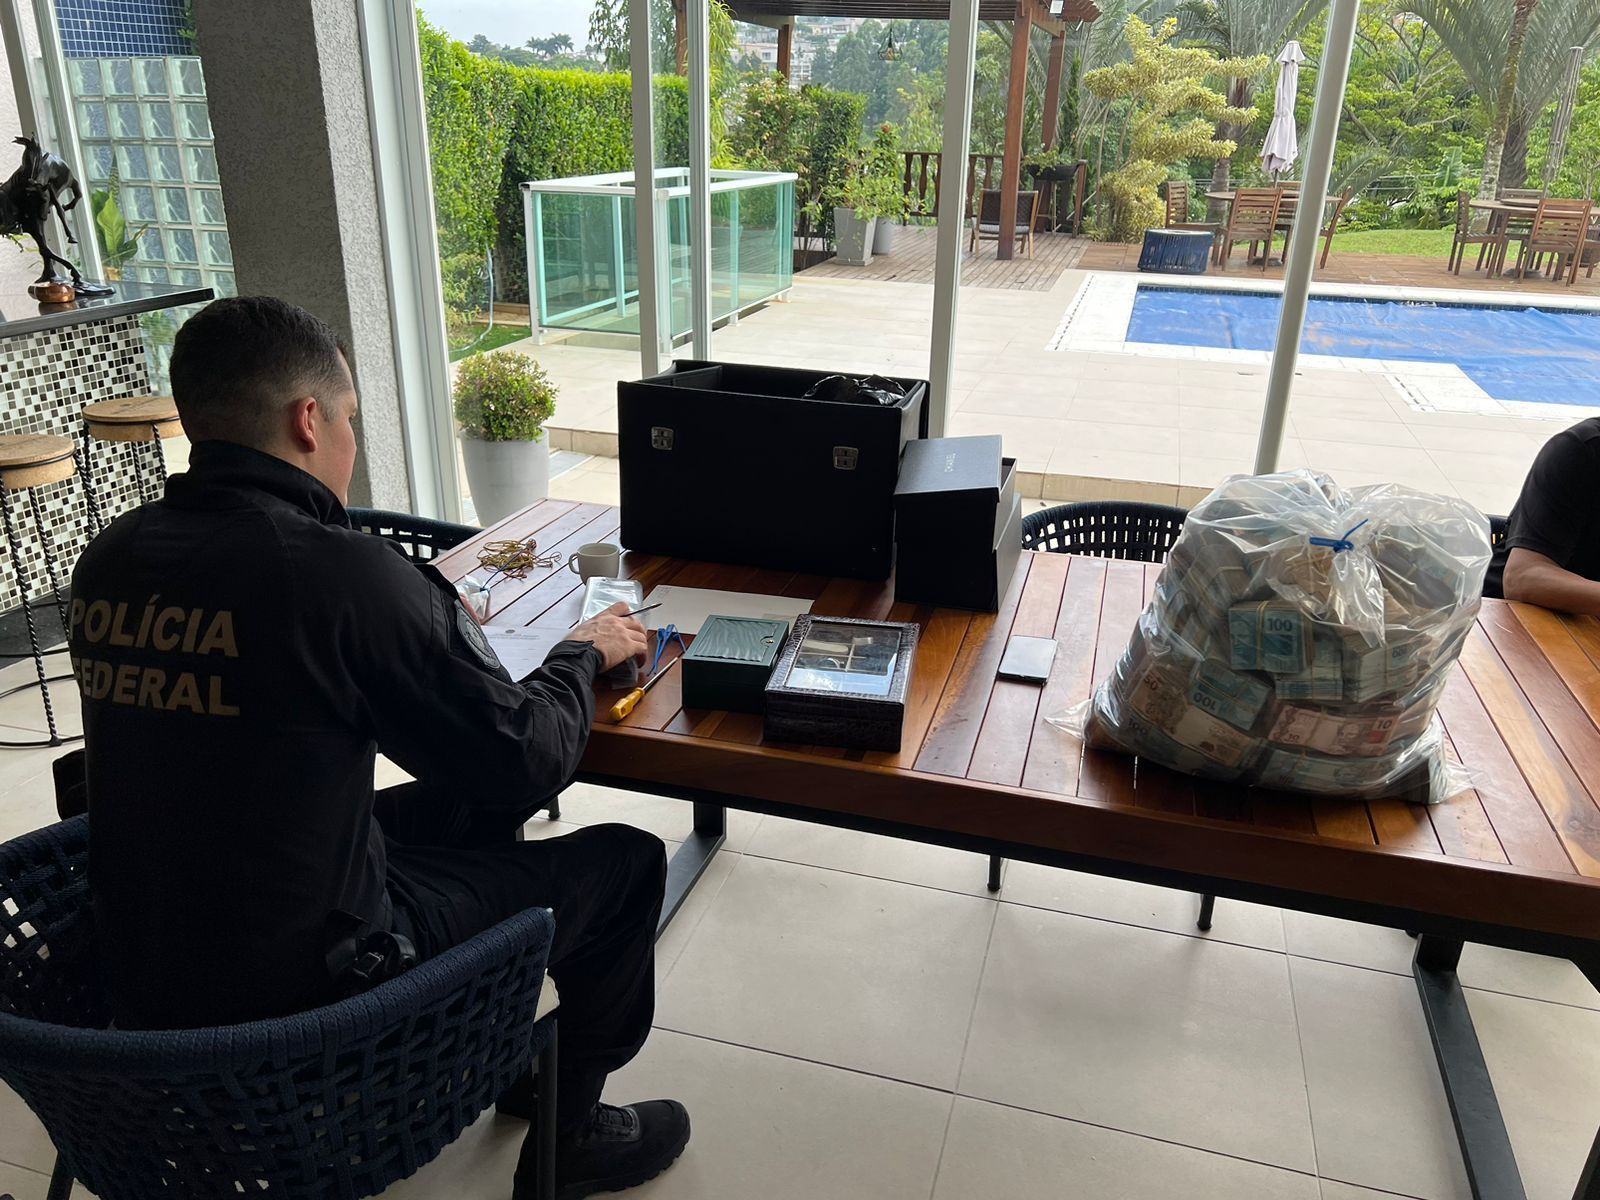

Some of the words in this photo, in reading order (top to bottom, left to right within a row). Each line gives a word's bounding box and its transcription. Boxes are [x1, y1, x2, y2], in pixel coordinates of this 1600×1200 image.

[69, 594, 239, 657] POLÍCIA
[1267, 618, 1293, 632] 100
[1143, 674, 1159, 691] 50
[1193, 692, 1217, 711] 100
[1376, 719, 1393, 730] 10
